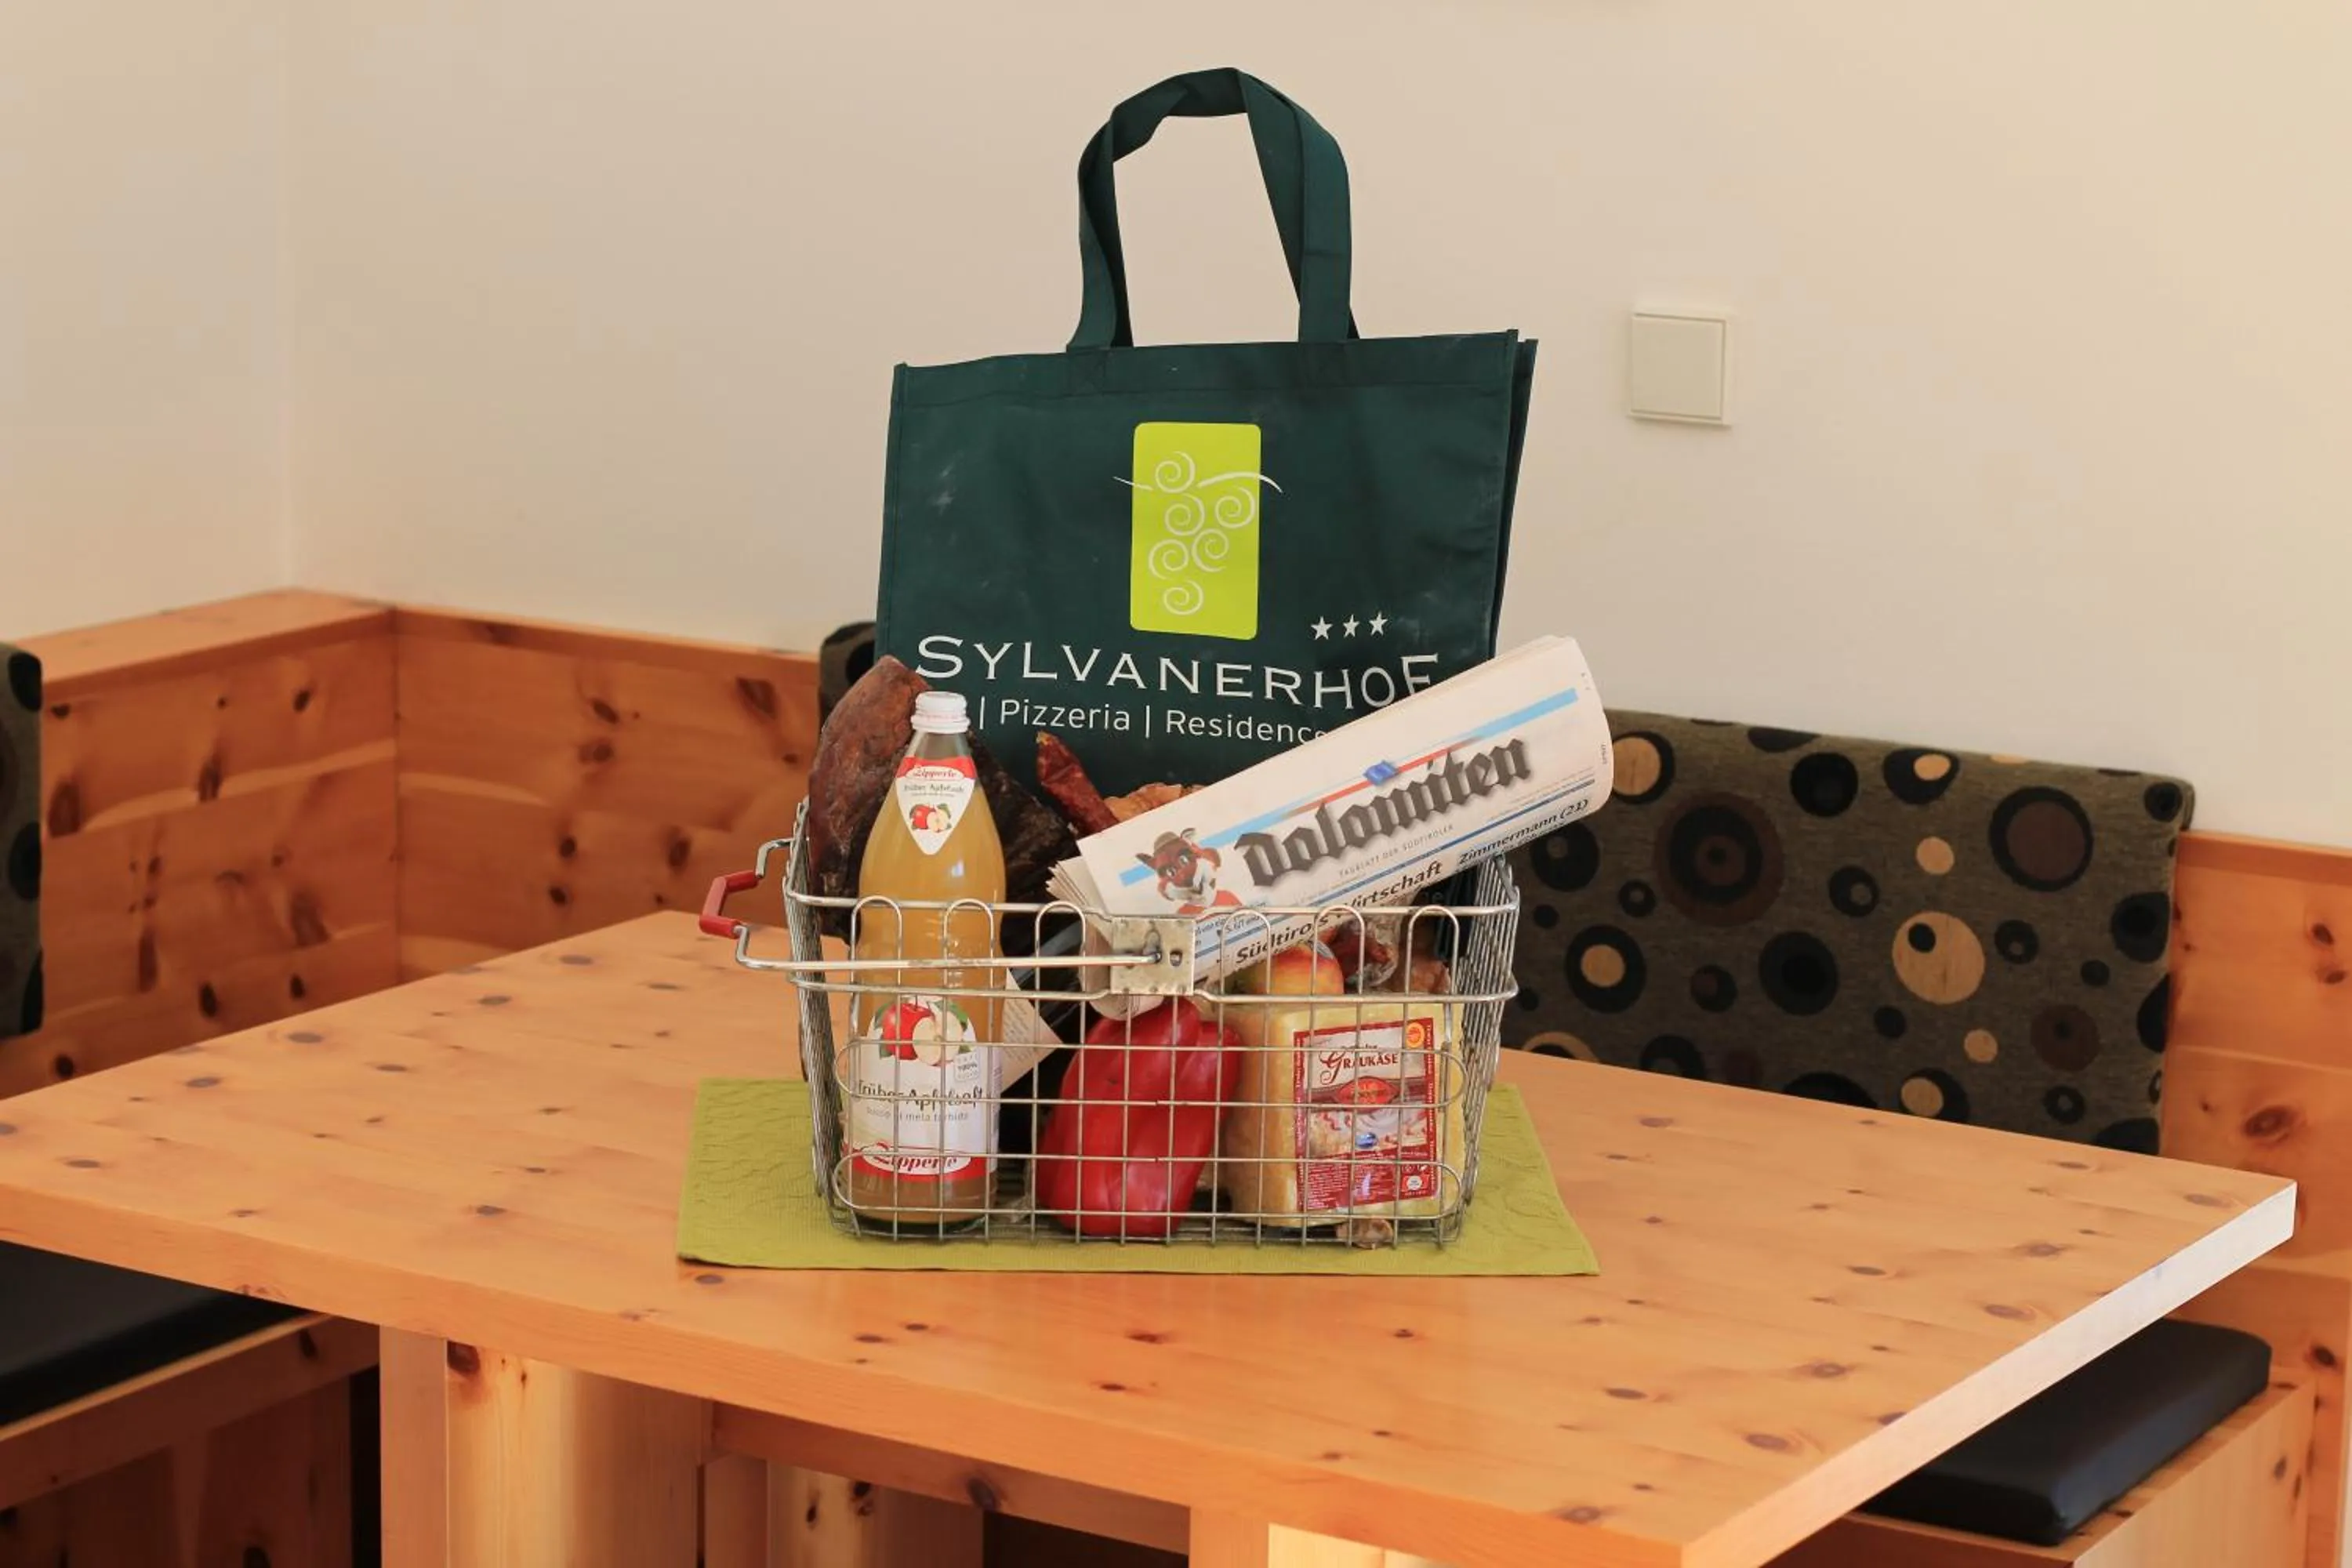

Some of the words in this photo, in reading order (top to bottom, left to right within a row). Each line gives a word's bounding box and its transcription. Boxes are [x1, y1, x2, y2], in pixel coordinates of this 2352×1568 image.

[915, 634, 1439, 710] SYLVANERHOF
[1000, 699, 1131, 731] Pizzeria
[1235, 738, 1531, 887] Dolomiten
[1459, 814, 1557, 864] Zimmermann
